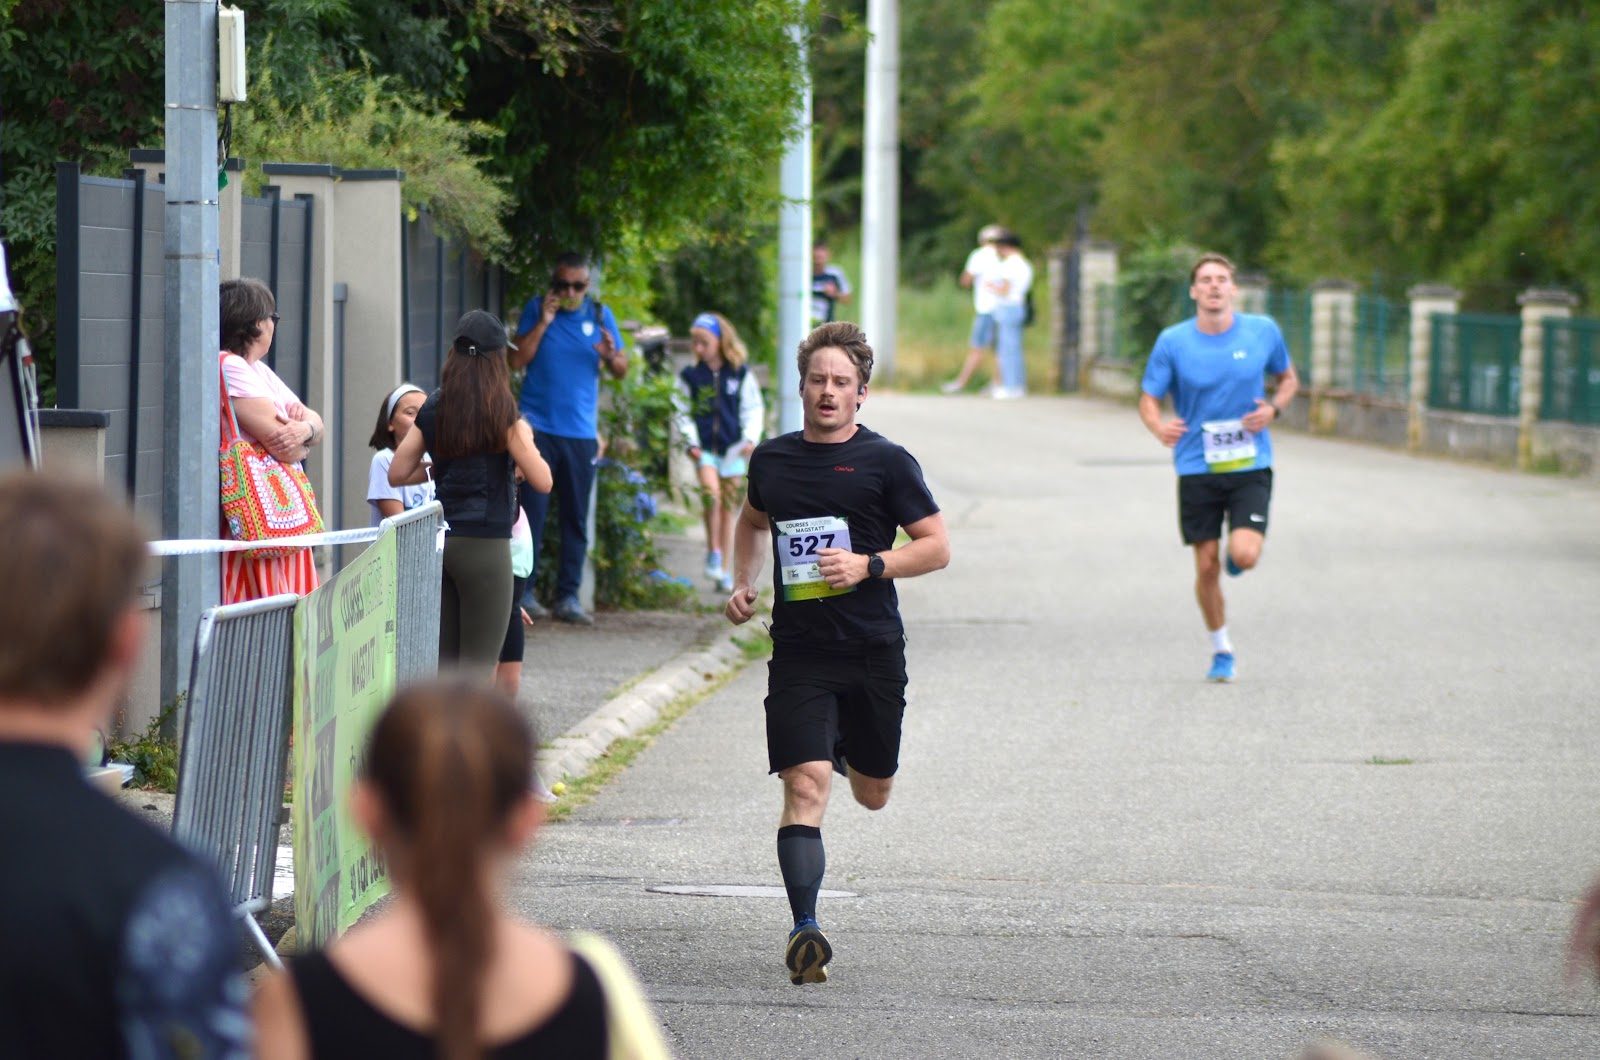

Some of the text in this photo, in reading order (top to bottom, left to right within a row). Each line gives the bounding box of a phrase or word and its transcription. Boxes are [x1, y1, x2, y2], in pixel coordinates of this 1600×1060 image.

[1213, 430, 1244, 446] 524
[795, 525, 825, 533] MAGSTATT
[789, 533, 835, 557] 527
